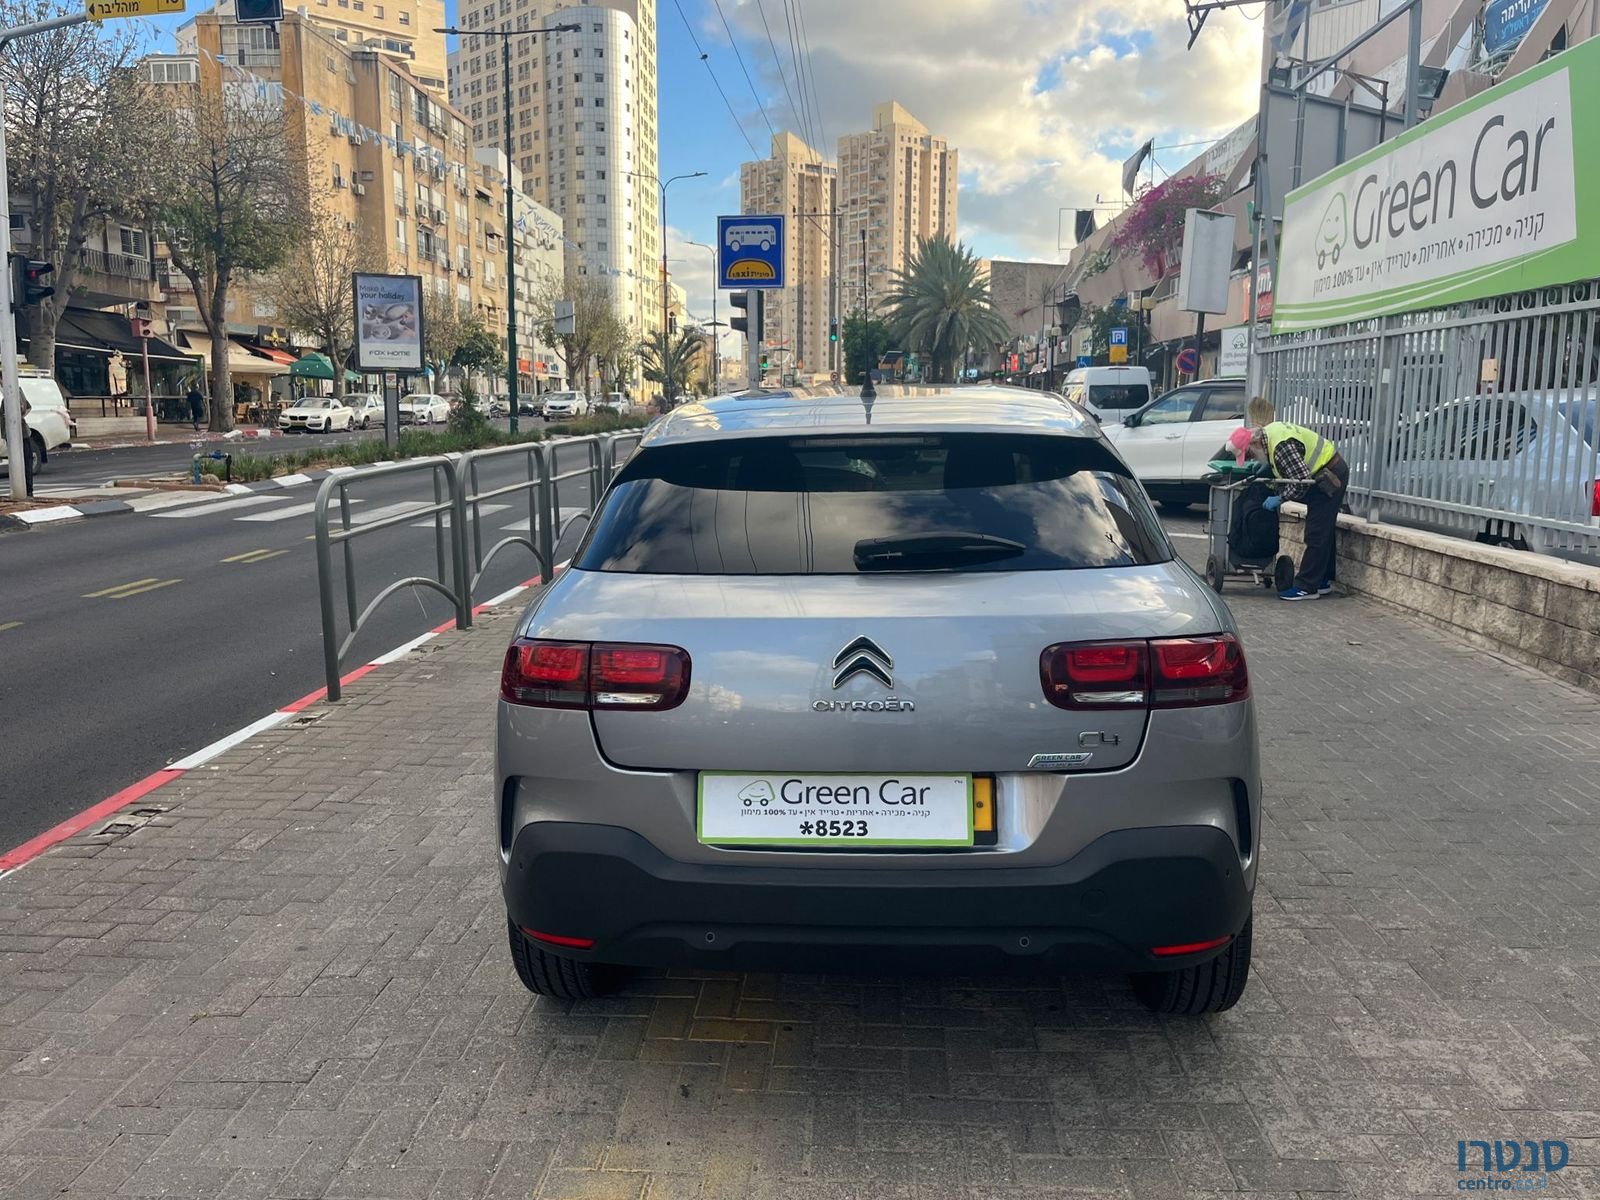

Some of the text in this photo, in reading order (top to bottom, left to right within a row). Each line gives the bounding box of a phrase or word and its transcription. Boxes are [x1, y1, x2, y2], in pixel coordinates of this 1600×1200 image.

[1353, 115, 1555, 249] Green Car
[1513, 212, 1545, 241] קניה
[1465, 224, 1503, 252] מכירה
[1386, 251, 1411, 273] טרייד
[1418, 237, 1457, 265] אחריות
[1332, 267, 1354, 289] 100%
[1355, 265, 1366, 282] עד
[1370, 260, 1384, 282] אין
[360, 292, 377, 300] your
[1079, 730, 1120, 748] C4
[780, 778, 931, 806] Green Car
[740, 808, 931, 818] קניה מכירה אחריות טרייד אין עד 100% מימון
